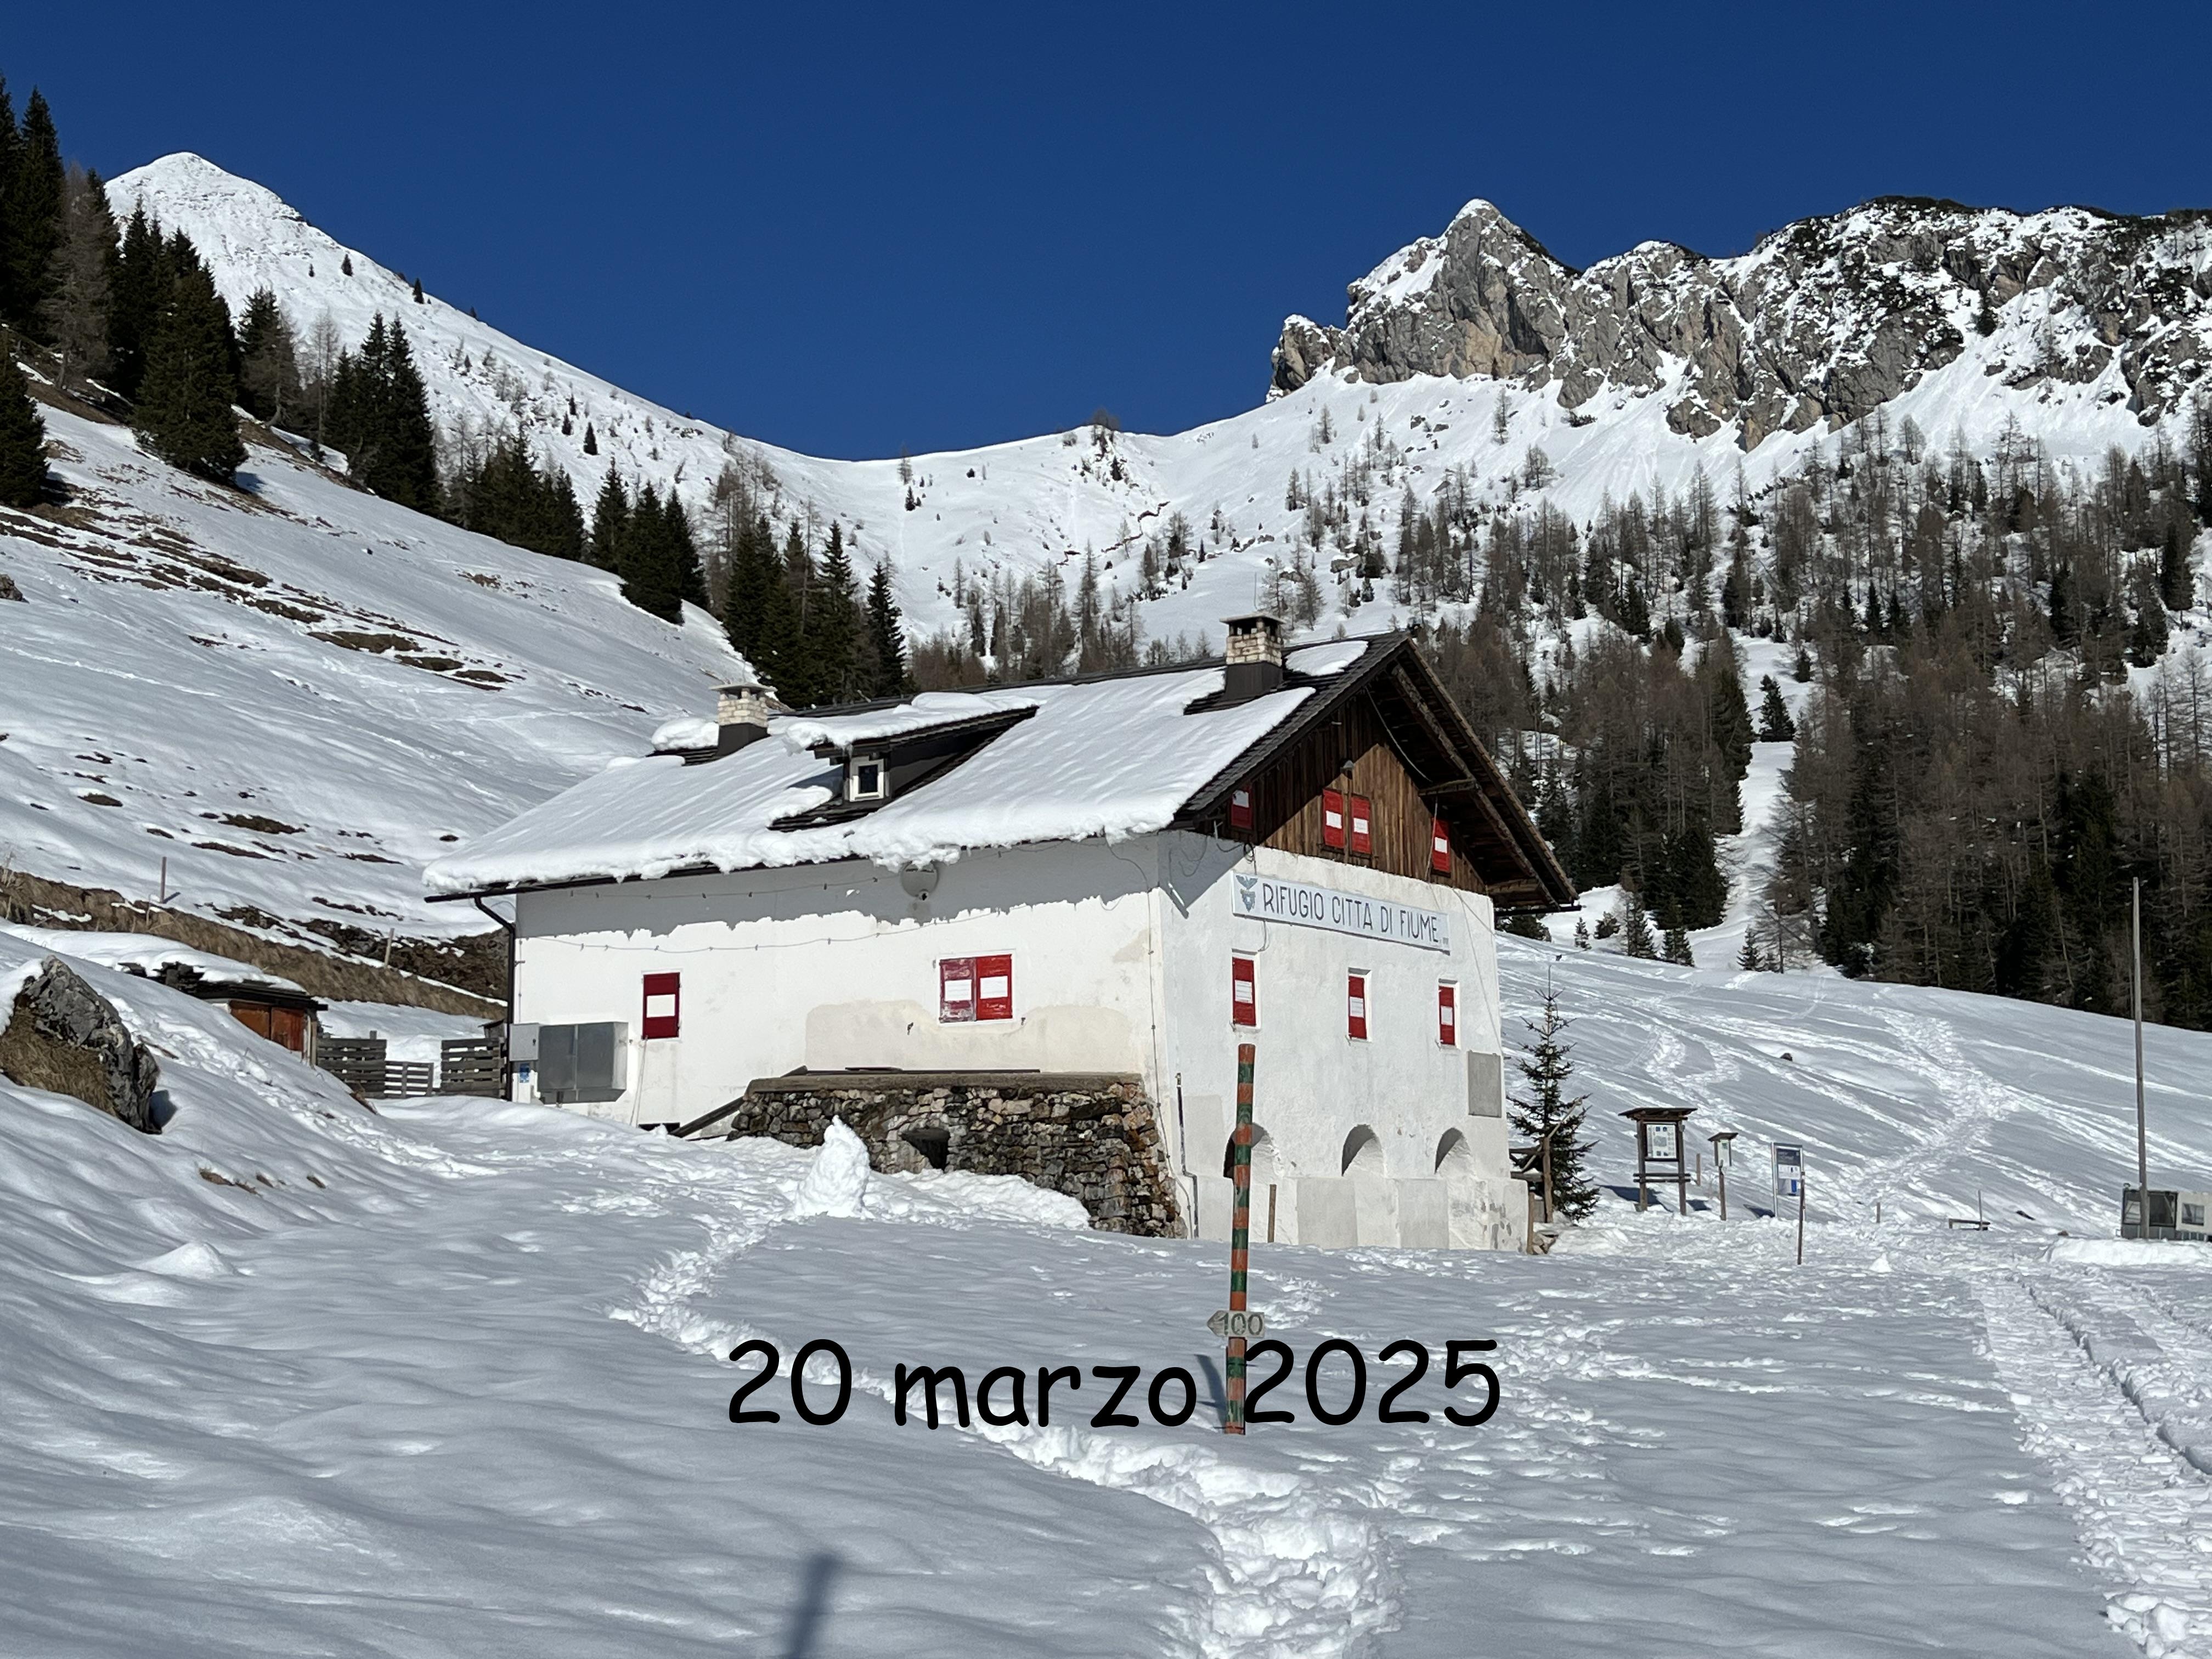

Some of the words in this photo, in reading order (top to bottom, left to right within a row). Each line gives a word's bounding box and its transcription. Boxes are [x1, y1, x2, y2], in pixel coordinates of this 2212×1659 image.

[1262, 882, 1325, 921] RIFUGIO
[1380, 905, 1393, 935] DI
[1400, 909, 1439, 943] FIUME
[1218, 1312, 1263, 1336] 100
